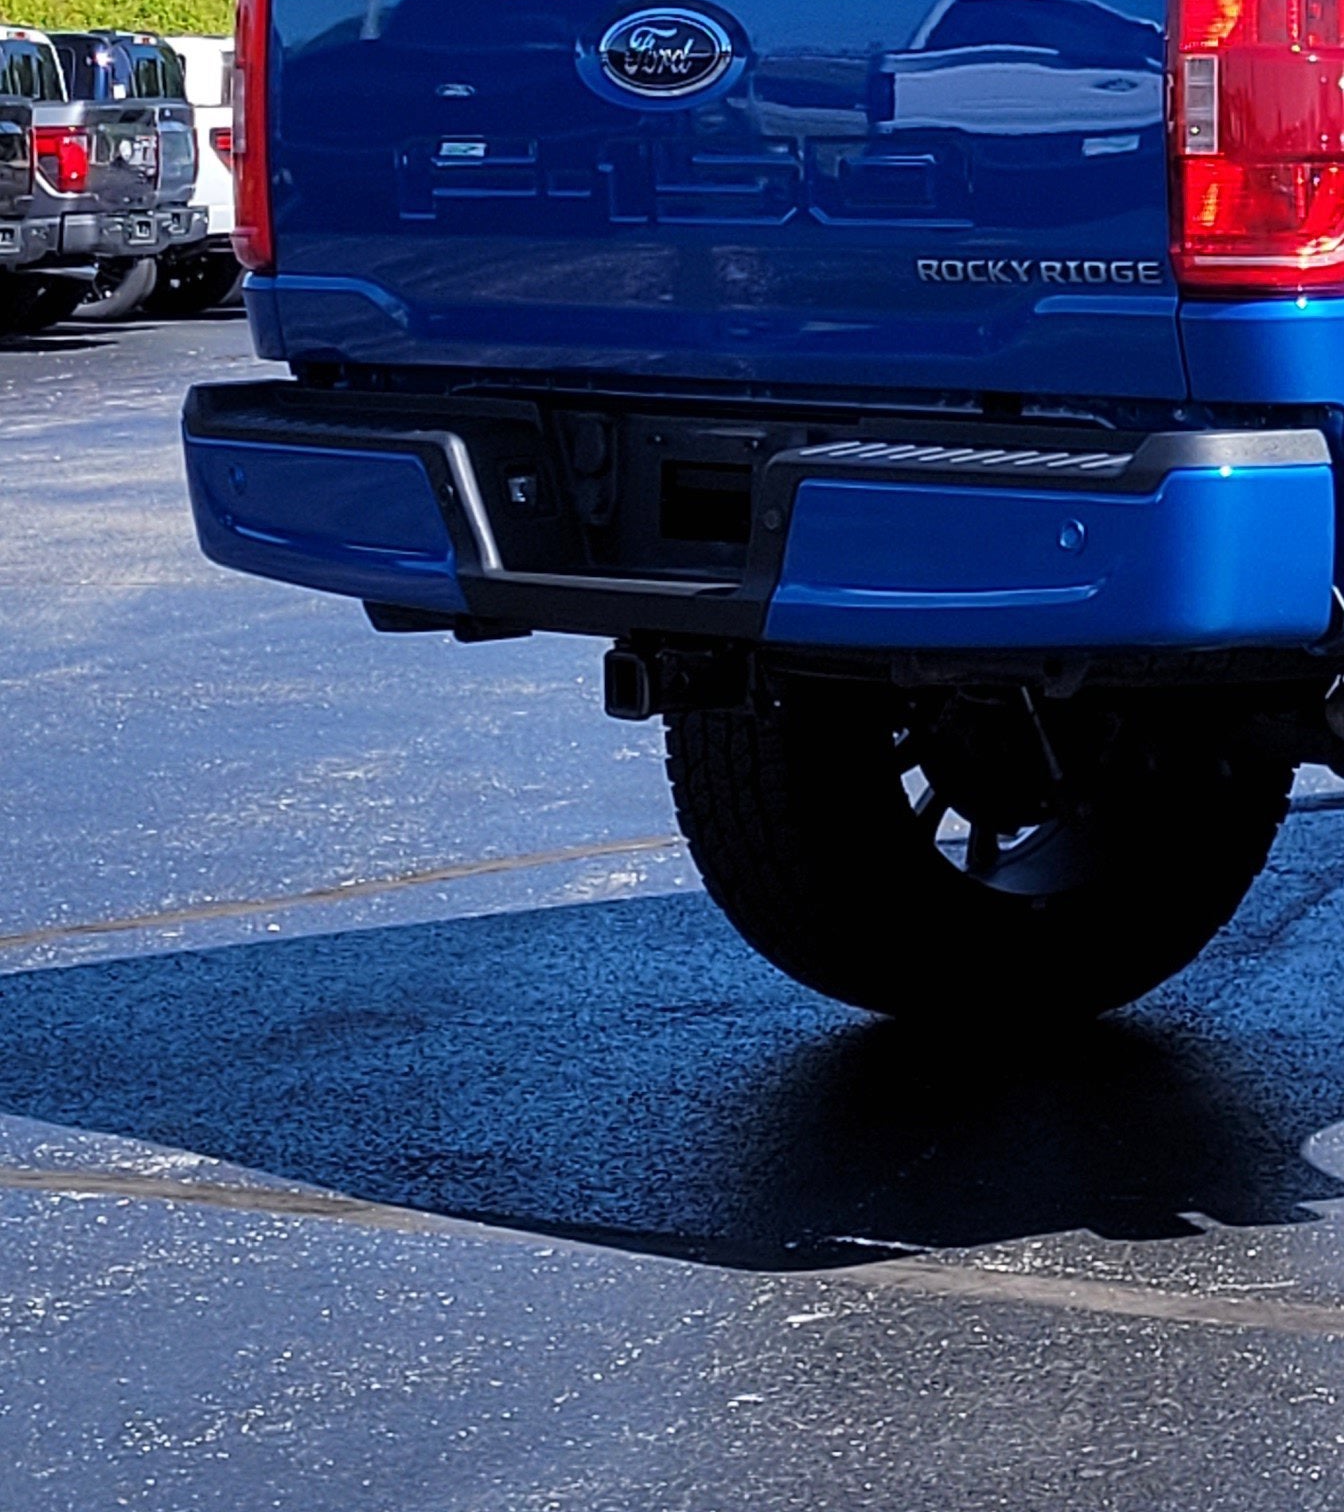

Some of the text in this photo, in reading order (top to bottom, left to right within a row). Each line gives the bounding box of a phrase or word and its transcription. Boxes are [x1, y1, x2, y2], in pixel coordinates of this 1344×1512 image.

[624, 26, 694, 76] Ford
[916, 259, 1164, 285] ROCKY RIDGE
